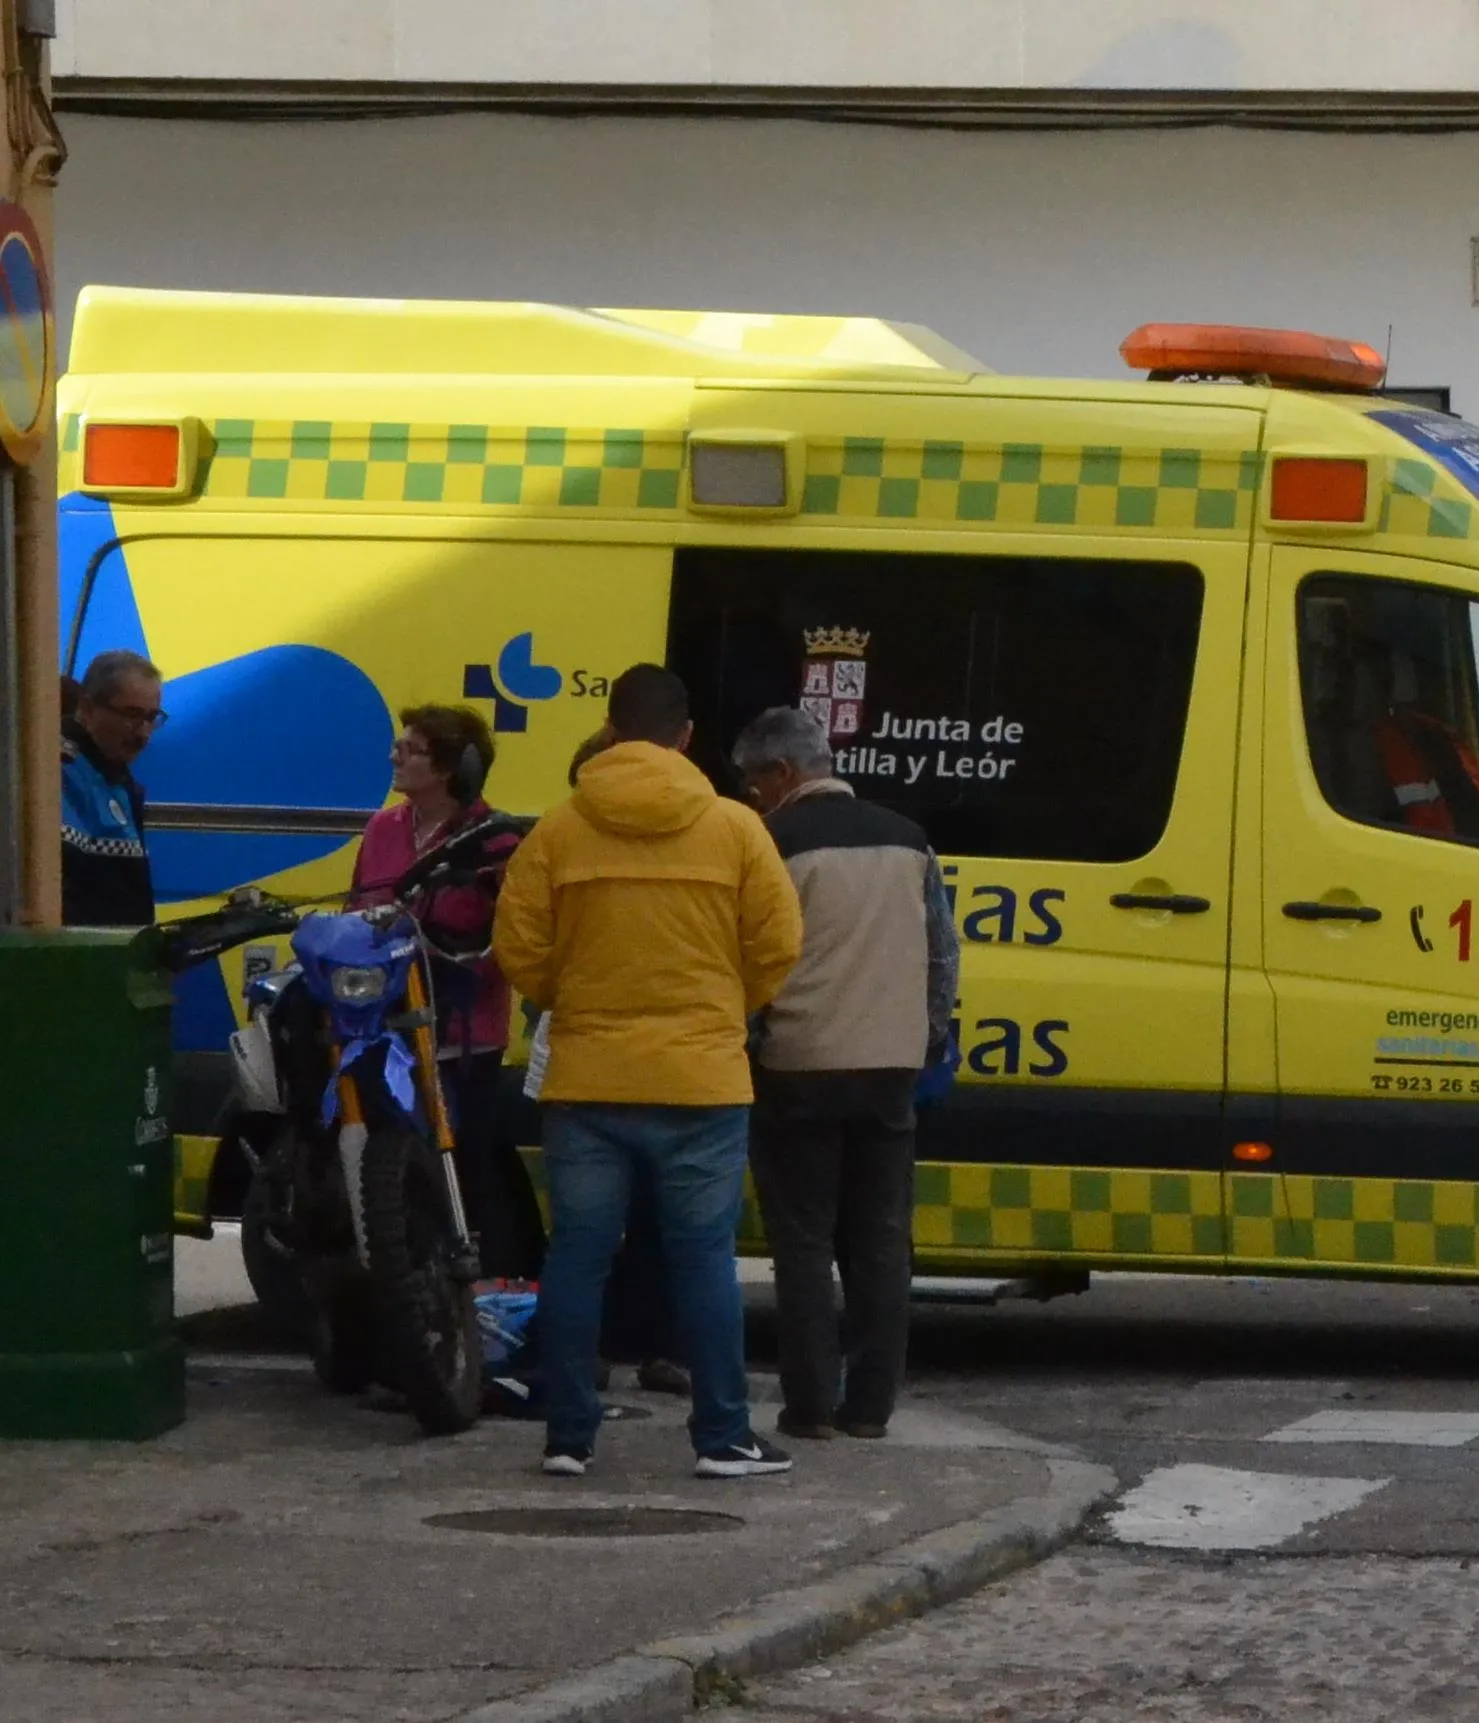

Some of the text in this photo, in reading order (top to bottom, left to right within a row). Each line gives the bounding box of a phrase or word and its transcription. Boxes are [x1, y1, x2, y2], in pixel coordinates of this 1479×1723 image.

[871, 711, 1024, 744] Junta de
[834, 746, 897, 775] tilla
[904, 754, 928, 785] y
[942, 866, 1065, 946] ias
[950, 998, 1070, 1078] ias
[1396, 1077, 1433, 1092] 923
[1440, 1078, 1463, 1093] 26
